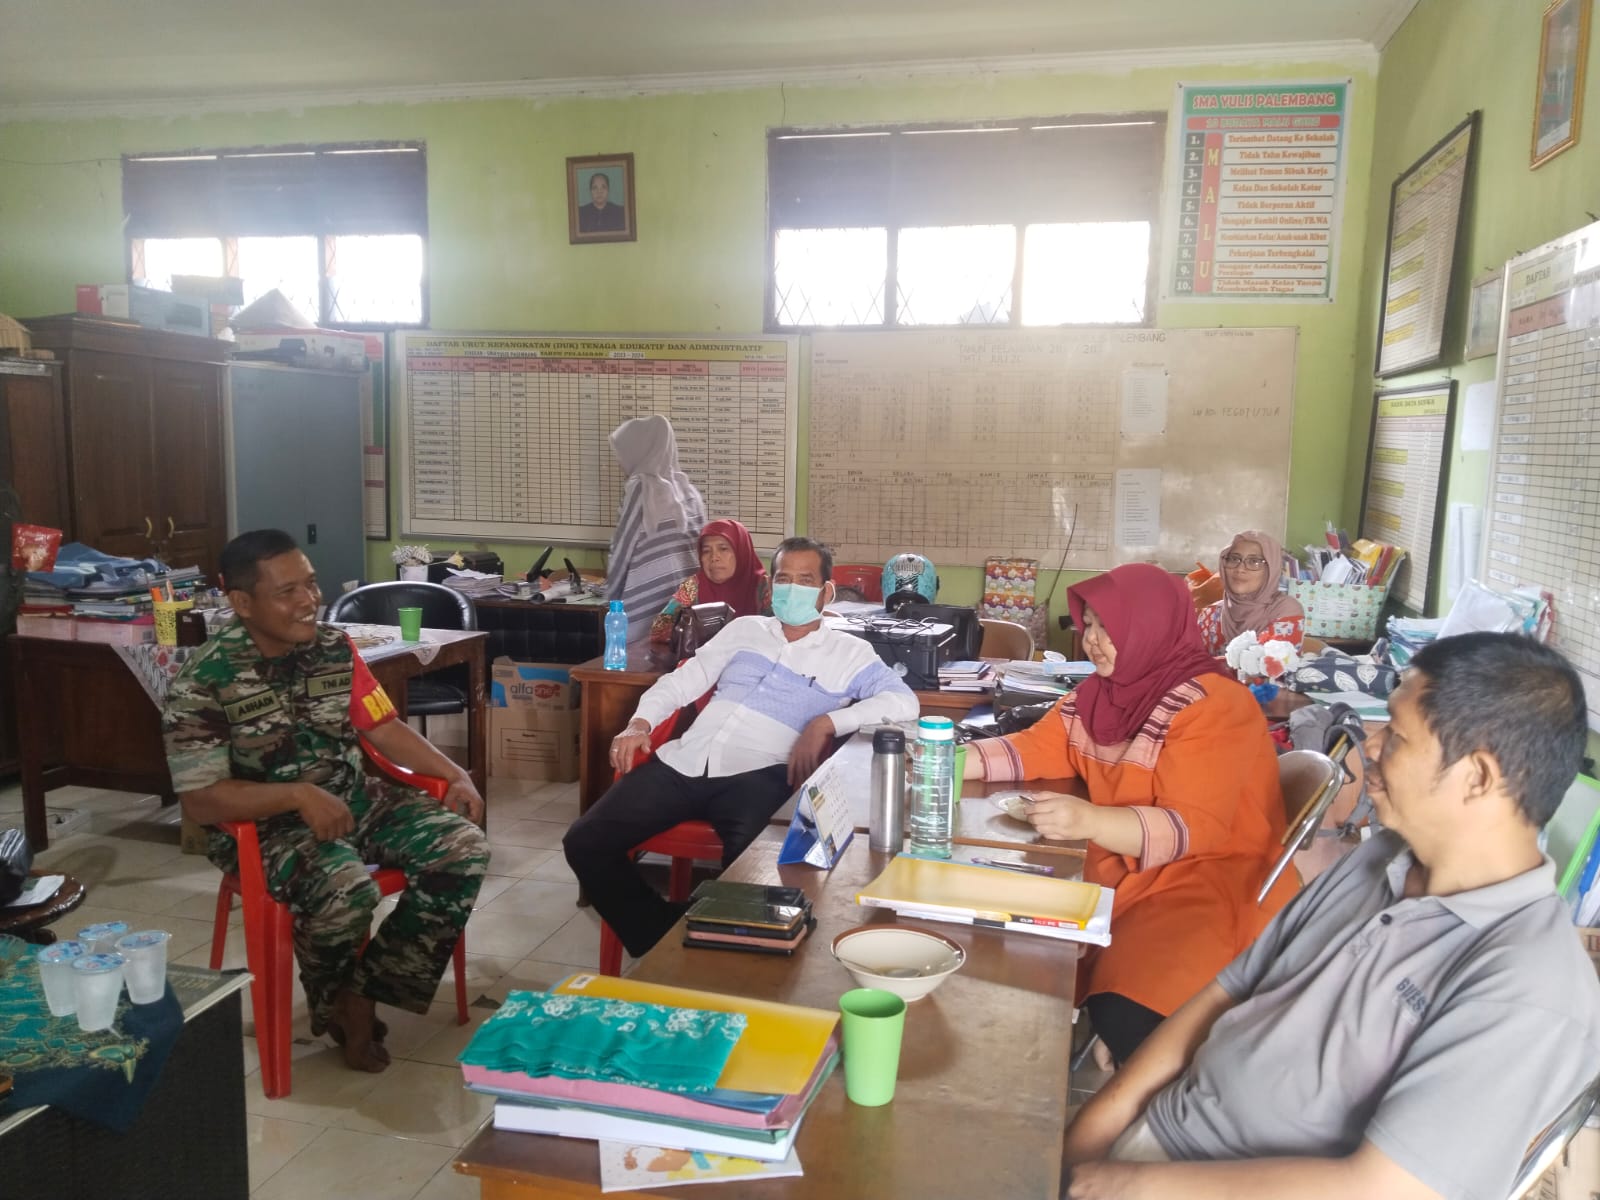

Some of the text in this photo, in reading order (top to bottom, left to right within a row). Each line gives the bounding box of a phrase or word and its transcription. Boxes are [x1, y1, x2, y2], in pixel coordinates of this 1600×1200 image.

[1193, 92, 1336, 108] SMA YULIS PALEMBANG
[1190, 136, 1200, 144] 1.
[1267, 134, 1292, 144] Datang
[1294, 134, 1304, 142] Ke
[1305, 133, 1335, 142] Sekolah
[1190, 152, 1199, 161] 2.
[1282, 151, 1321, 159] Kewajiban
[1188, 168, 1198, 178] 3.
[1307, 168, 1328, 176] Kerja
[1183, 233, 1193, 243] 7.
[1180, 266, 1190, 275] 9.
[1177, 282, 1191, 291] 10.
[321, 677, 350, 690] TNI AD
